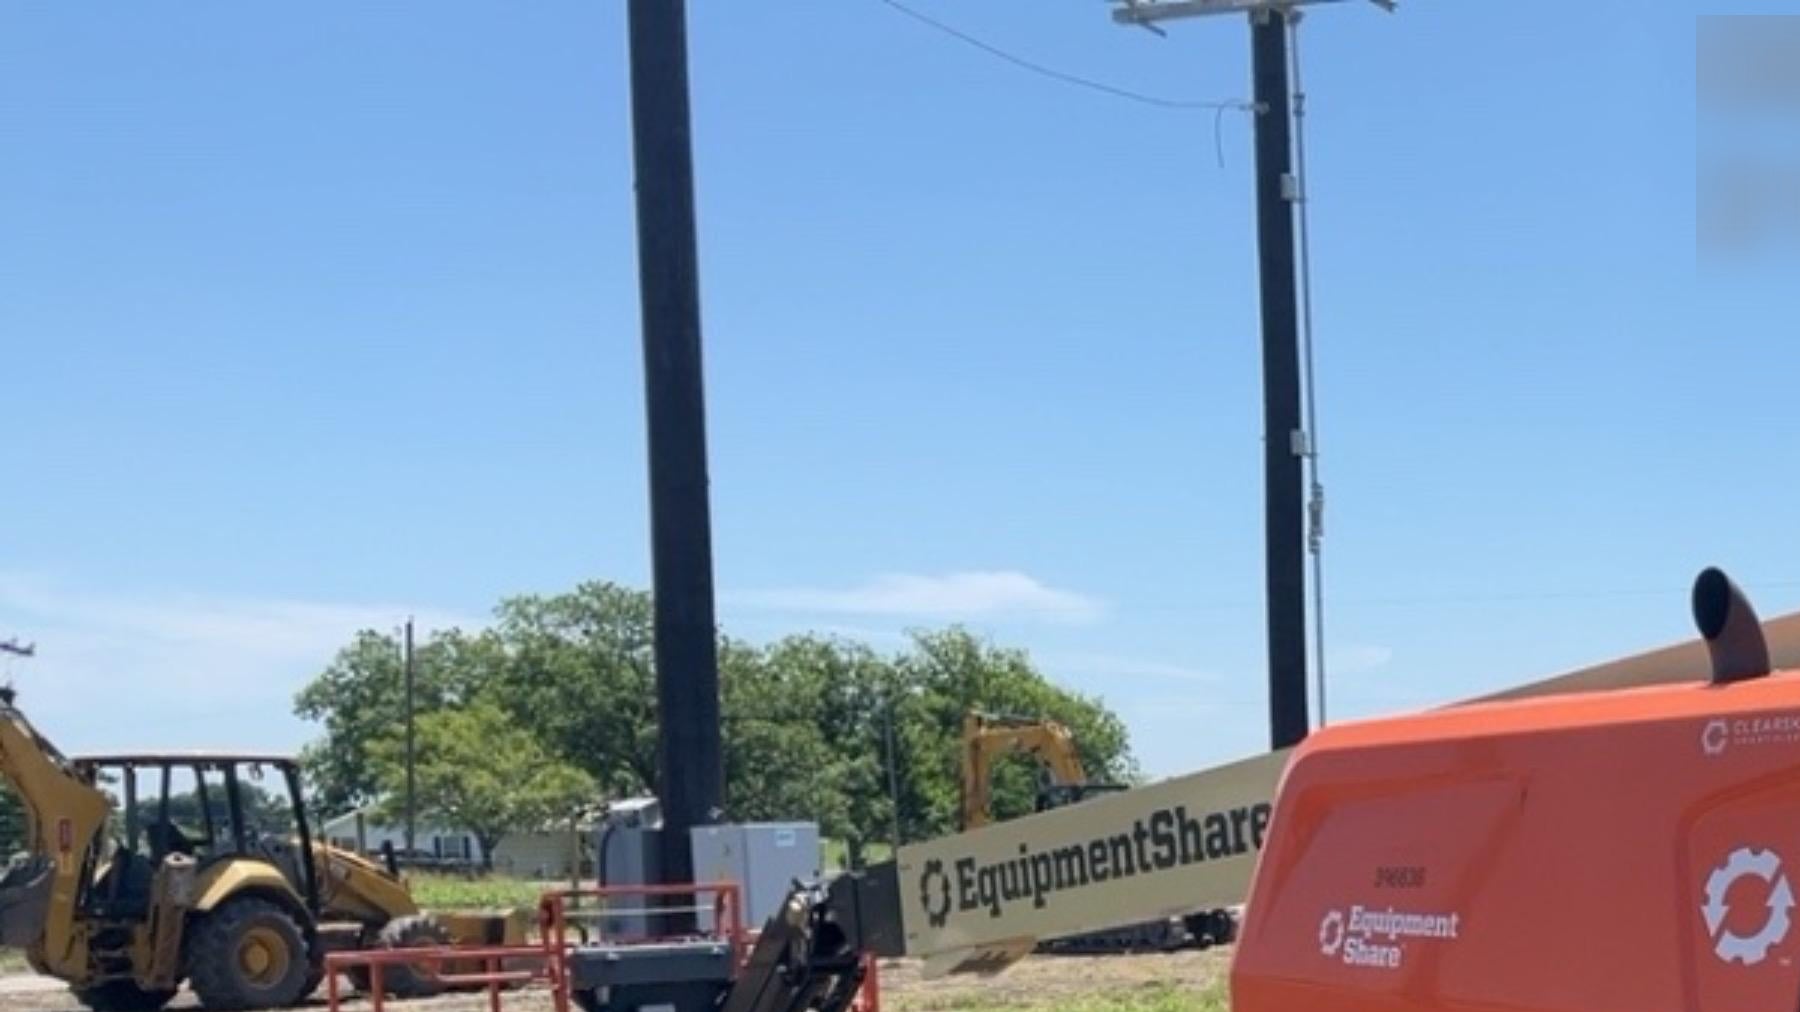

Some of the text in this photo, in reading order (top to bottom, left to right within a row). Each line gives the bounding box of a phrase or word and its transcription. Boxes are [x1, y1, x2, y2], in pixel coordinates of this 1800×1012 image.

[955, 802, 1275, 917] EquipmentShare
[1348, 905, 1459, 940] Equipment
[1343, 937, 1401, 968] Share
